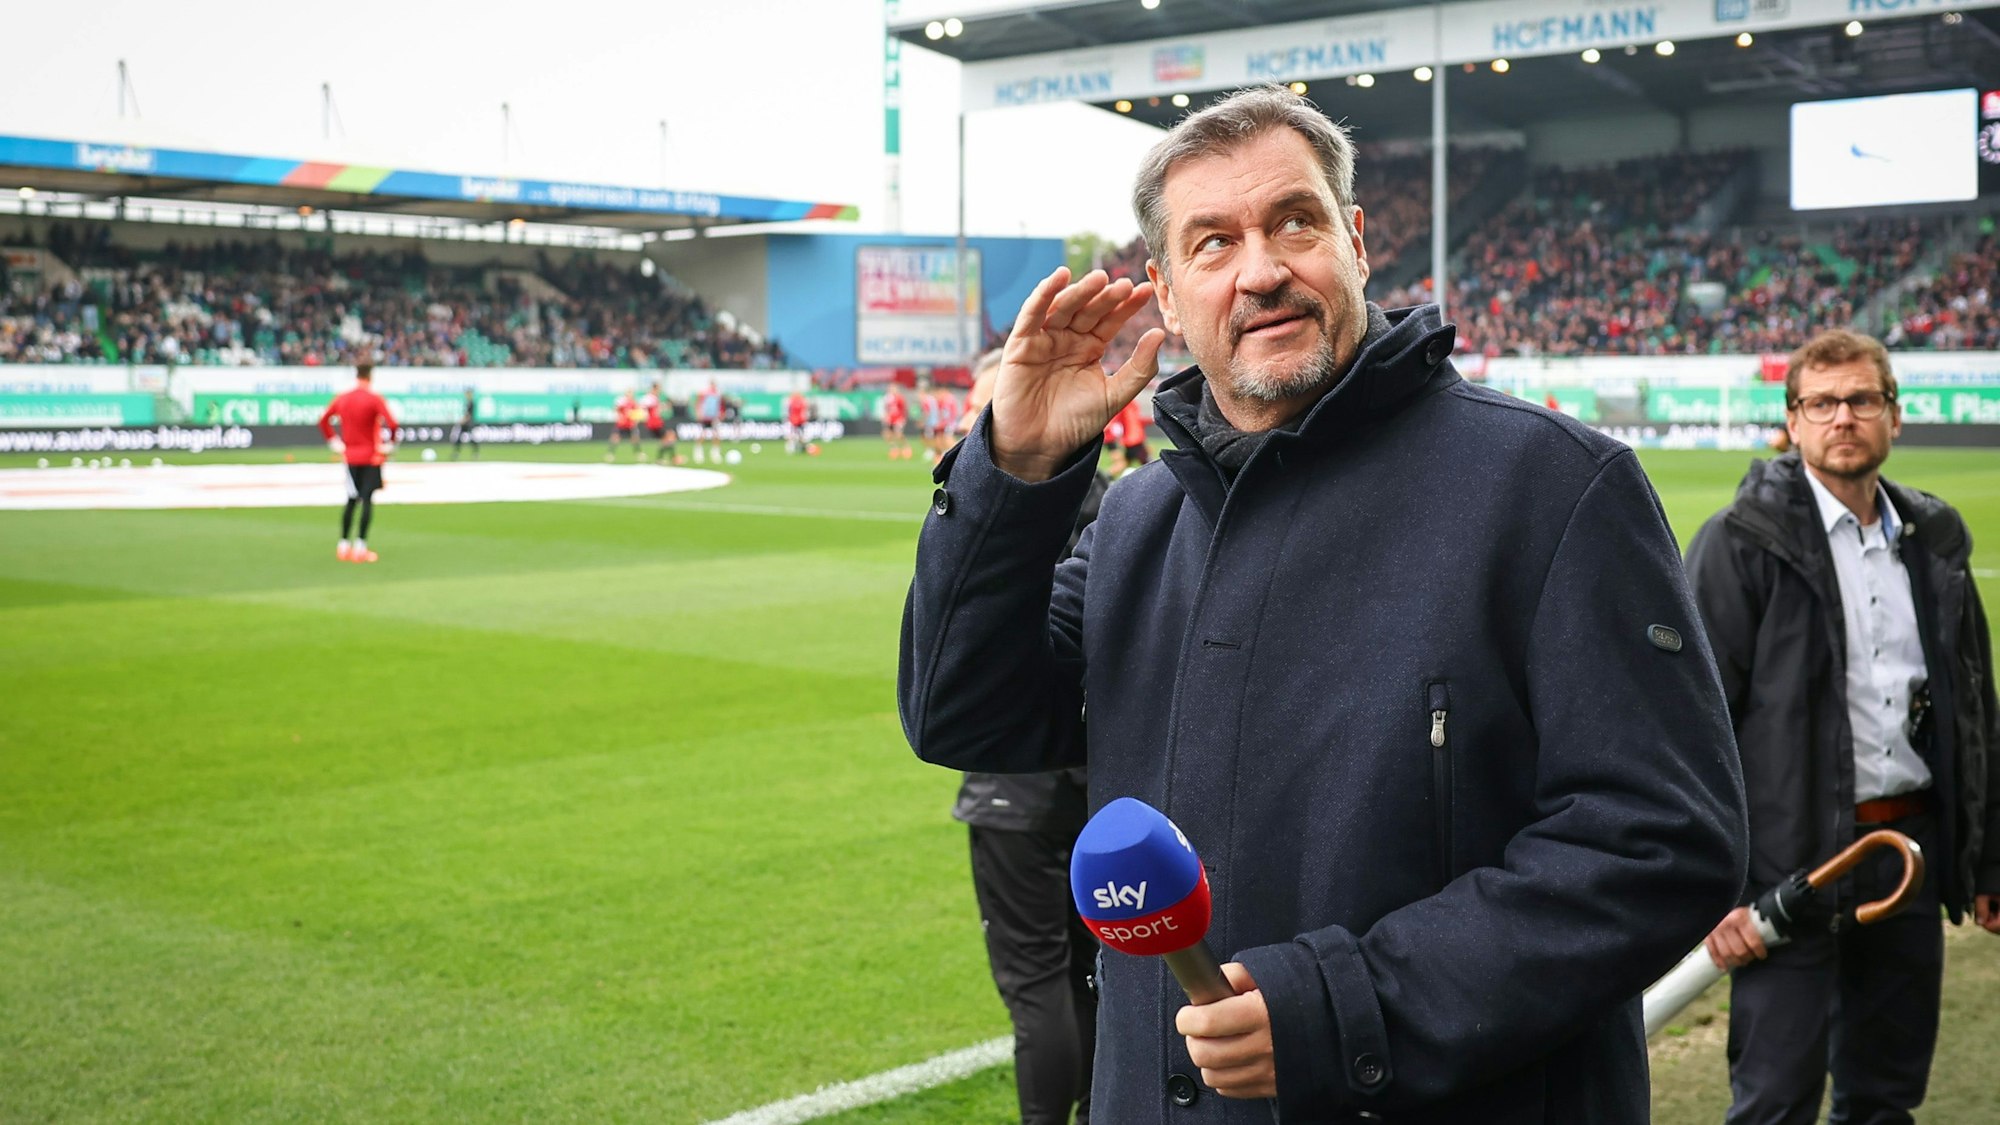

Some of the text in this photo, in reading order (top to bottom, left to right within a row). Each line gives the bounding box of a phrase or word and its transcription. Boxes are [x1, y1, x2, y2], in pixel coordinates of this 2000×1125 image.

[1491, 10, 1658, 52] HOFMANN
[1246, 39, 1387, 76] HOFMANN
[995, 71, 1113, 105] HOFMANN
[1897, 392, 1950, 424] CSL
[0, 424, 253, 453] www.autohaus-biegel.de
[1092, 880, 1147, 910] sky
[1099, 915, 1179, 943] sport
